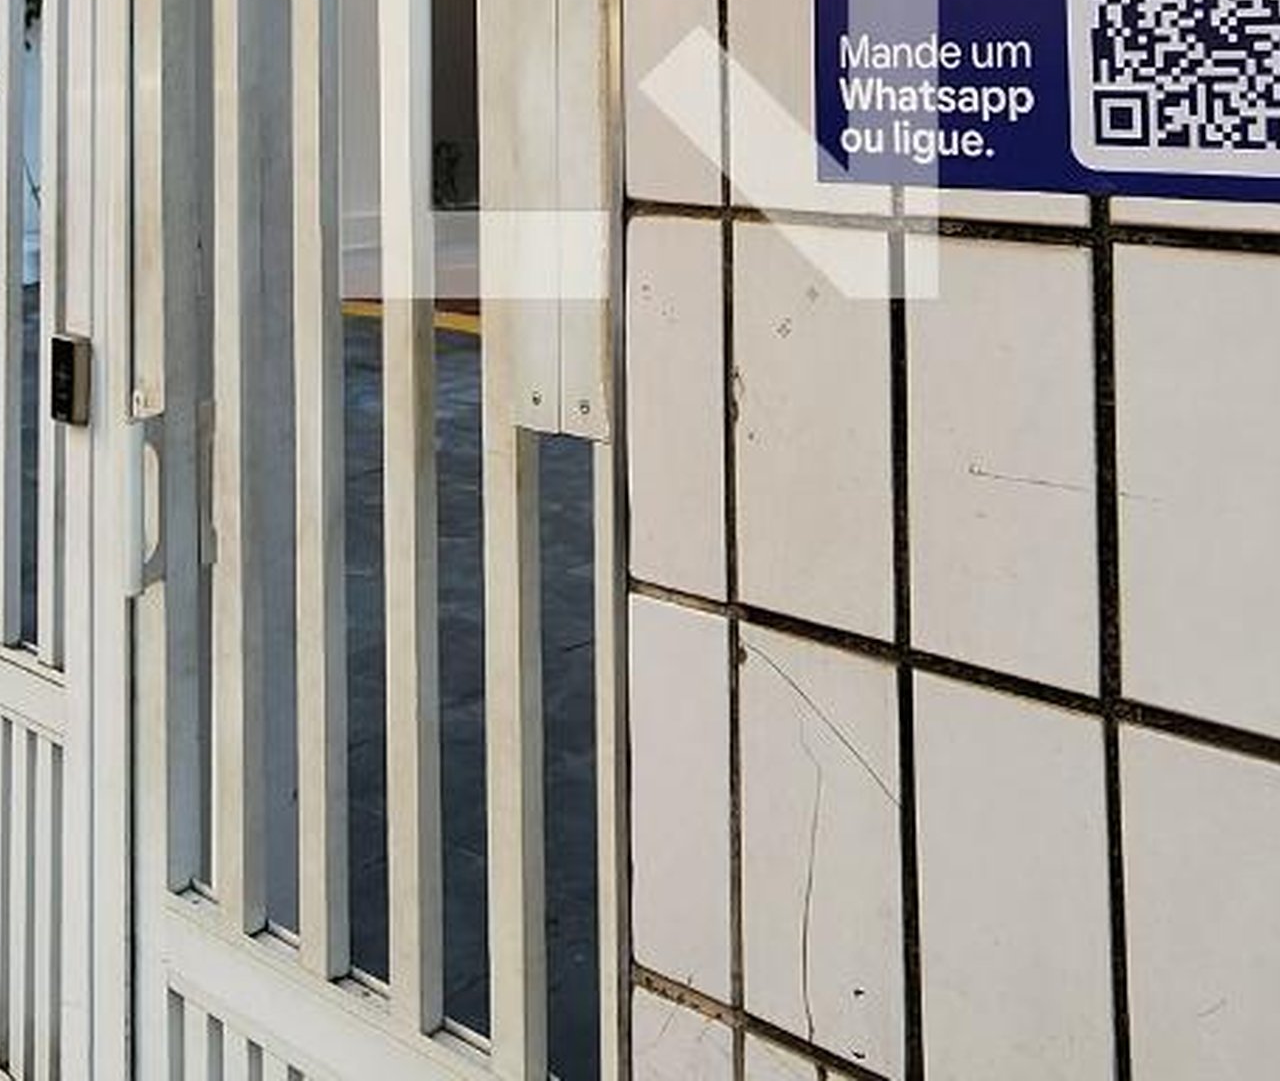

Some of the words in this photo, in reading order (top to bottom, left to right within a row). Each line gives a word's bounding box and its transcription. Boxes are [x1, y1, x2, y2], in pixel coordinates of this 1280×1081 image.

[839, 34, 961, 69] Mande
[972, 40, 1032, 69] um
[838, 77, 1035, 121] Whatsapp
[840, 126, 883, 154] ou
[893, 121, 995, 164] ligue.
